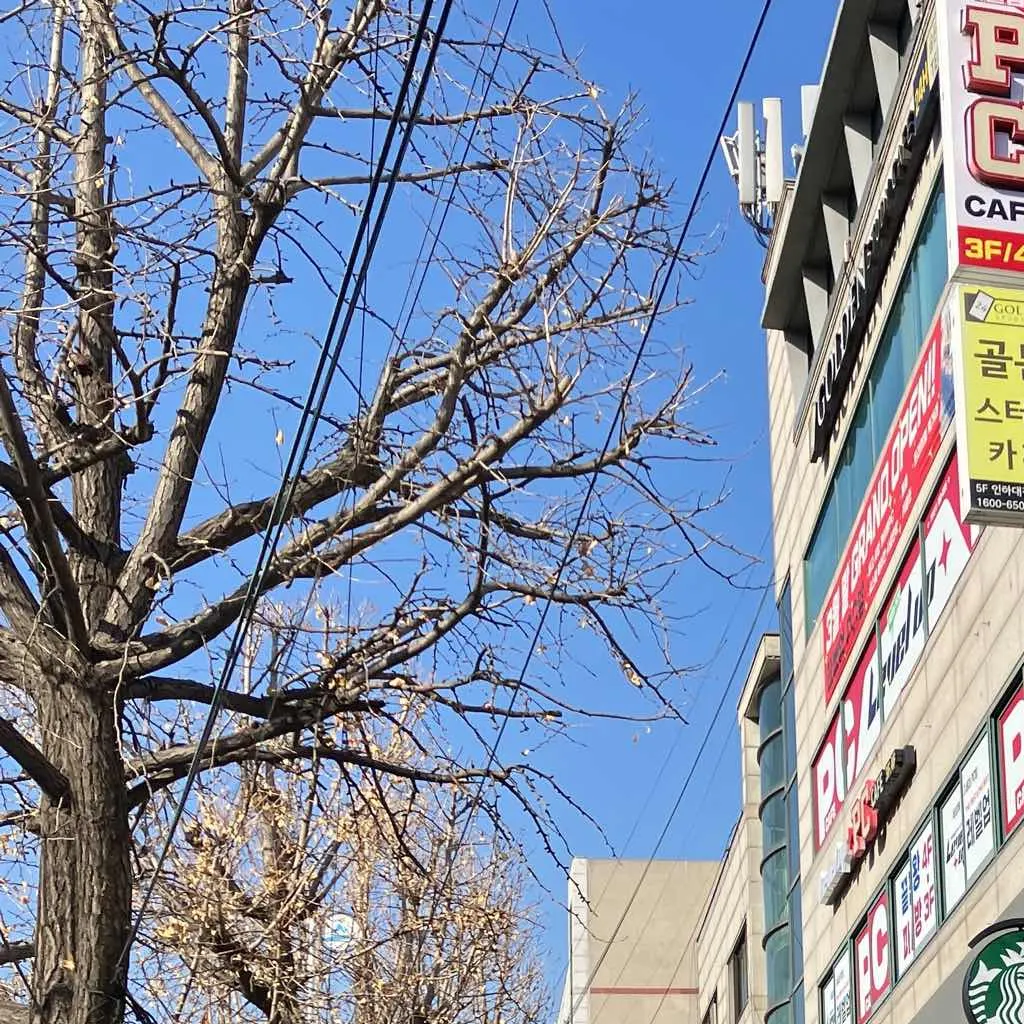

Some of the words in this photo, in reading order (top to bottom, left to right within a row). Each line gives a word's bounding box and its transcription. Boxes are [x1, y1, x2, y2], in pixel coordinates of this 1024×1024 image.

[851, 461, 890, 588] GRAND
[976, 483, 989, 493] 5F
[816, 699, 856, 848] PC
[858, 903, 889, 1019] PC
